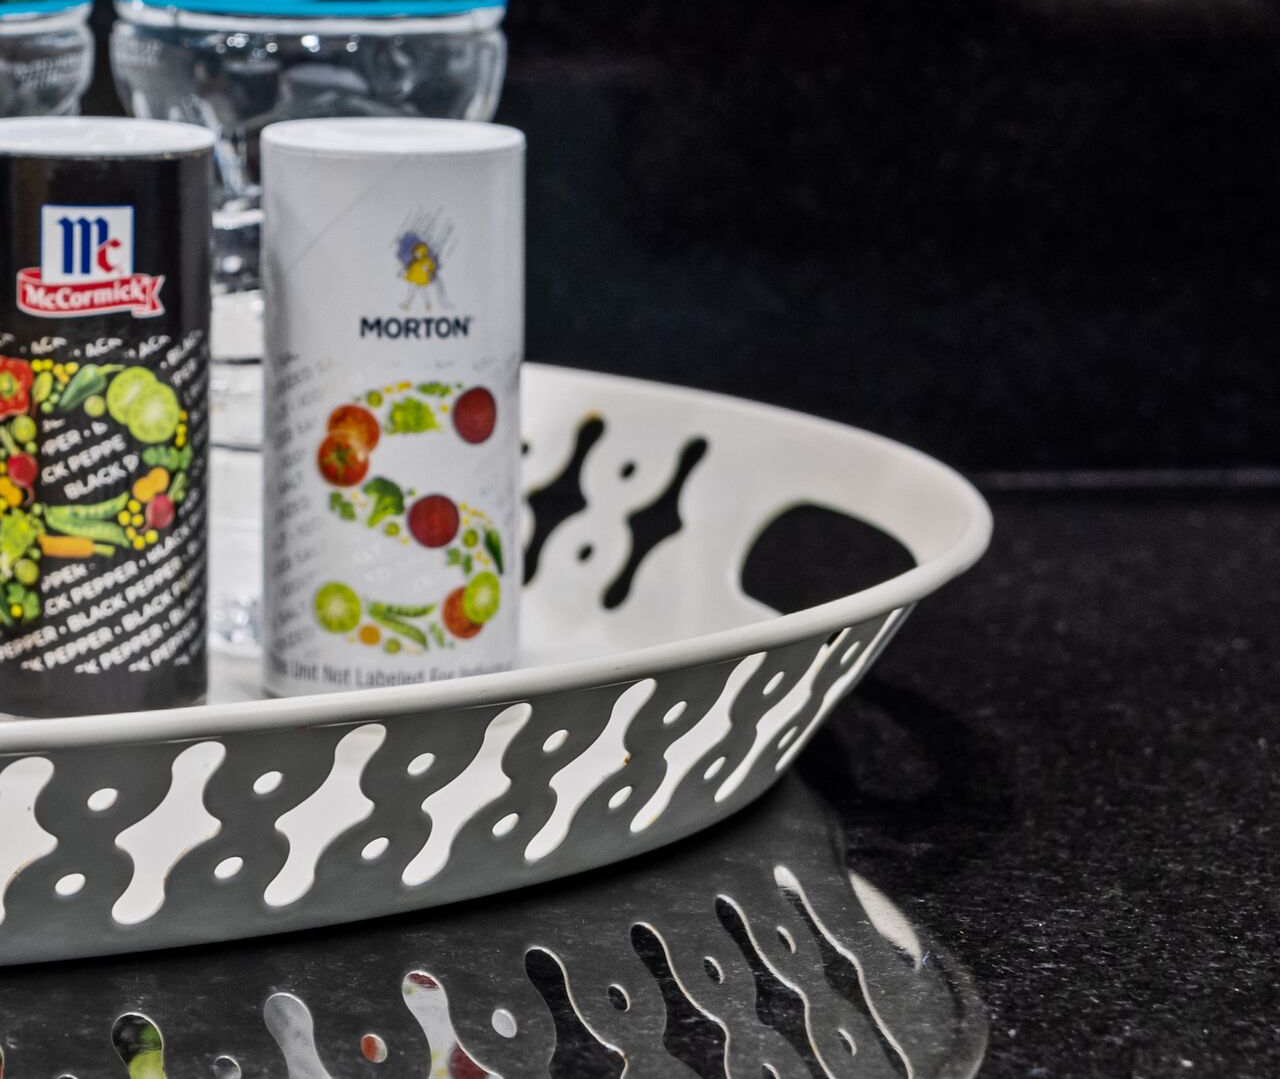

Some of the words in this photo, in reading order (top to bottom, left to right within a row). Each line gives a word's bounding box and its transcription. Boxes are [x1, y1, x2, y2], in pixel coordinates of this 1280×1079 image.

[22, 274, 144, 310] McCormick
[360, 316, 470, 339] MORTON
[64, 461, 128, 500] BLACK
[67, 591, 127, 633] BLACK
[125, 555, 183, 604] PEPPER
[70, 560, 139, 605] PEPPER
[43, 626, 115, 670] PEPPER
[121, 590, 175, 633] BLACK
[99, 623, 165, 671] PEPPER
